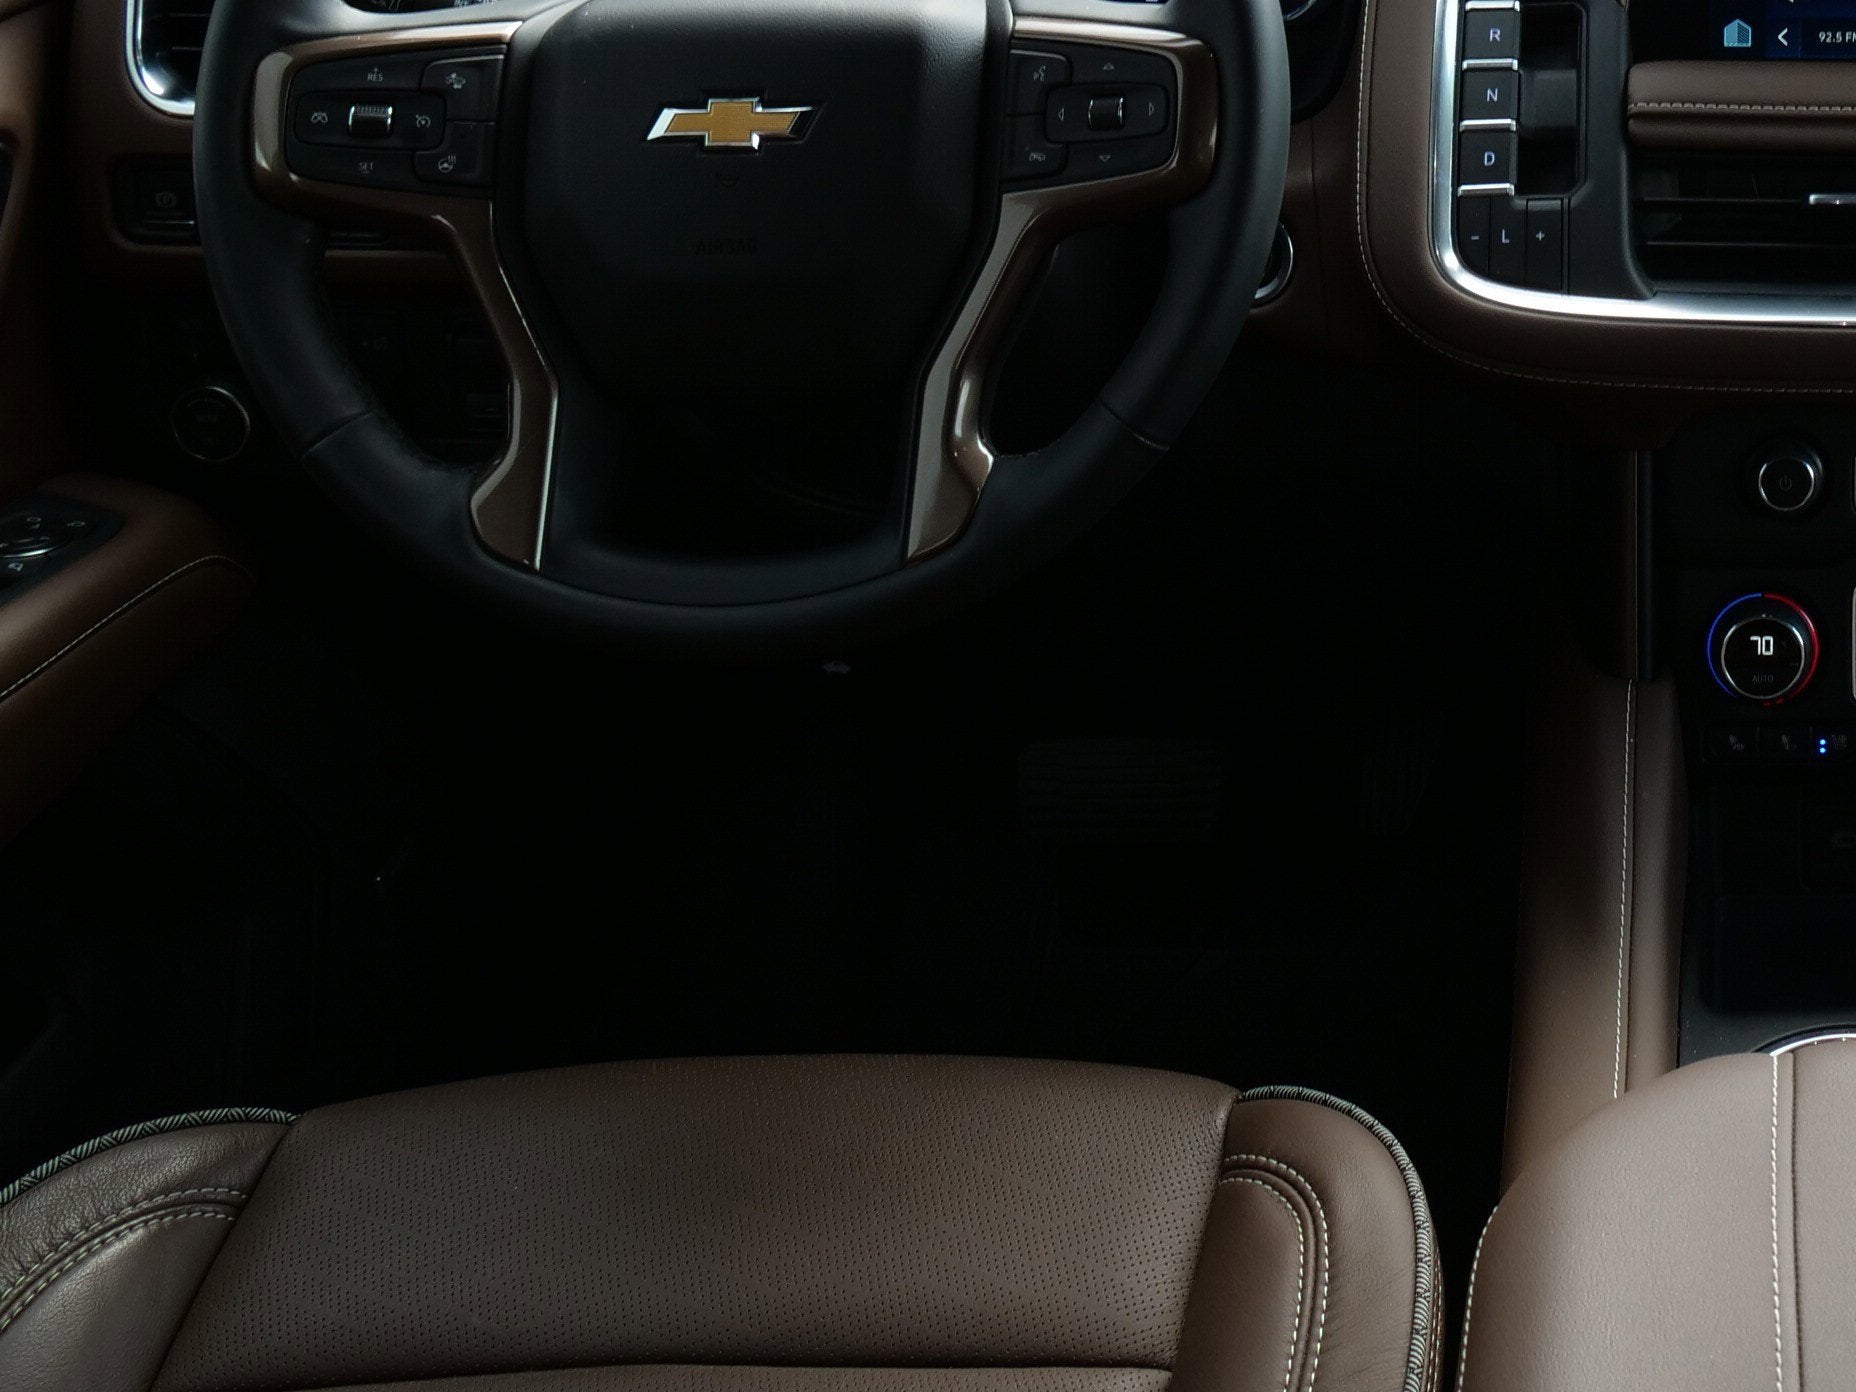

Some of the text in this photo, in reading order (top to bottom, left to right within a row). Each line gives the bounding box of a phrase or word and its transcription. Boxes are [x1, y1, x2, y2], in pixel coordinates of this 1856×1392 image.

[1489, 28, 1501, 42] R
[1818, 31, 1842, 44] 92.5
[367, 71, 384, 82] RES
[1487, 88, 1499, 102] N
[1484, 151, 1495, 166] D
[1501, 229, 1510, 244] L
[1749, 635, 1774, 657] 70
[1752, 673, 1774, 685] AUTO
